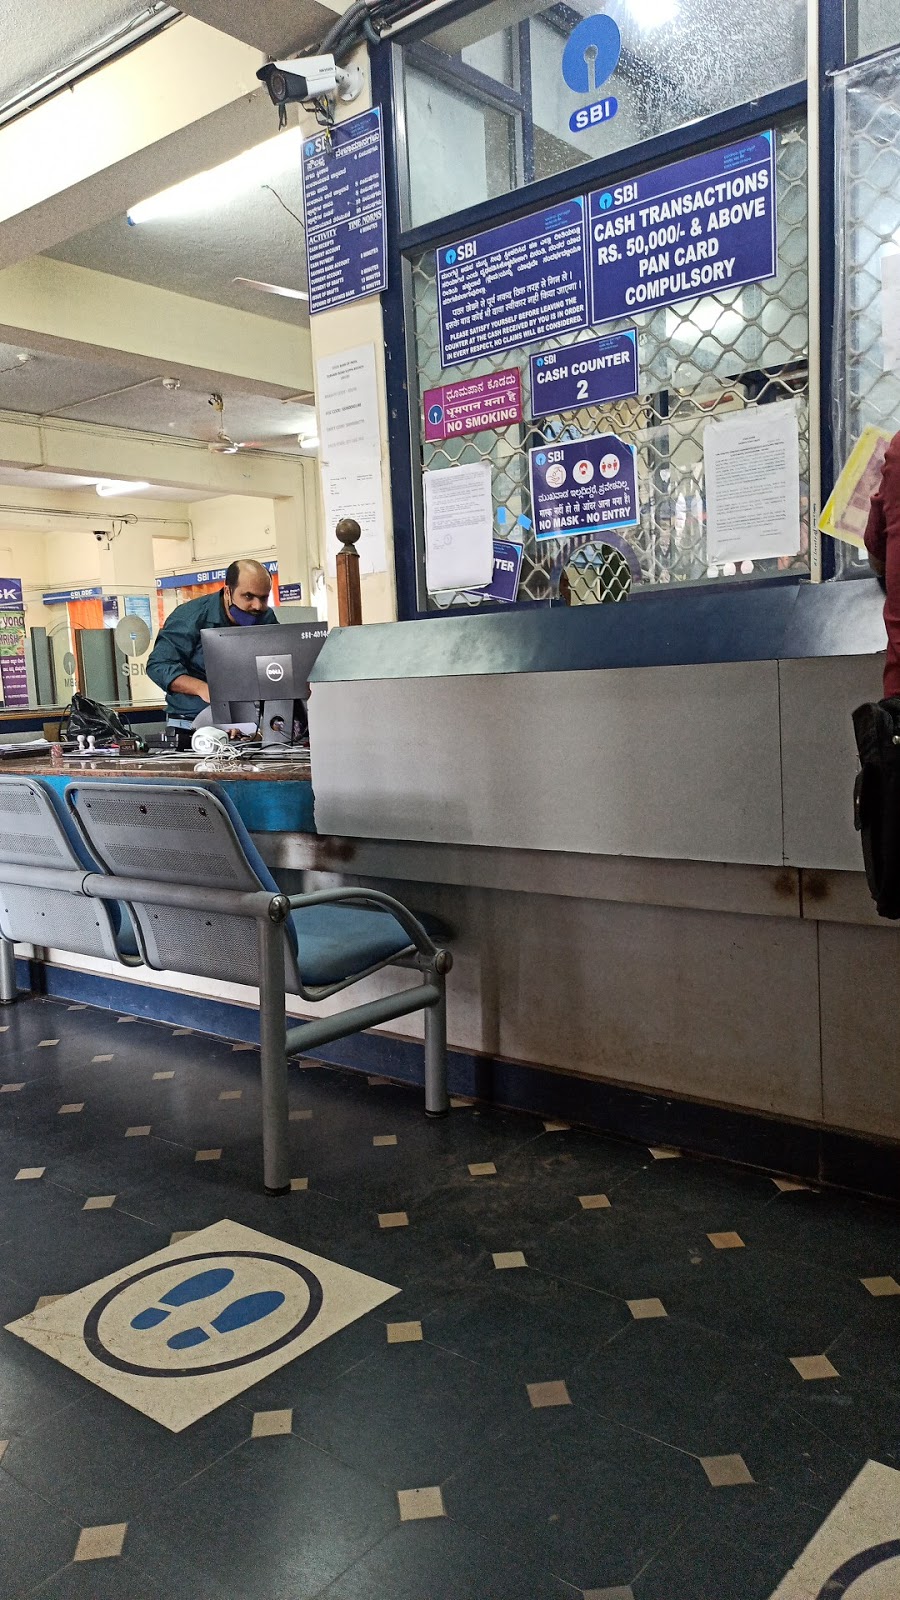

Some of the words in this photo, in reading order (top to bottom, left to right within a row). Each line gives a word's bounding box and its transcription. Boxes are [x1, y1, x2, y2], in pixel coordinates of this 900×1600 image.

[575, 101, 610, 128] SBI
[594, 213, 635, 242] CASH
[639, 169, 769, 227] TRANSACTIONS
[613, 182, 638, 205] SBI
[308, 228, 337, 245] ACTIVITY
[598, 244, 623, 265] RS.
[626, 223, 686, 256] 50,000/-
[690, 217, 702, 237] &
[707, 197, 766, 232] ABOVE
[457, 240, 477, 261] SBI
[639, 252, 670, 277] PAN
[674, 237, 719, 266] CARD
[625, 257, 736, 305] COMPULSORY
[444, 339, 469, 351] COUNTER
[468, 336, 476, 345] AT
[476, 333, 487, 342] THE
[487, 328, 502, 339] CASH
[502, 321, 528, 334] RECEIVED
[528, 317, 537, 327] BY
[537, 314, 549, 324] YOU
[550, 312, 556, 320] IS
[556, 310, 564, 318] IN
[564, 304, 584, 316] ORDER
[449, 329, 469, 341] PLEASE
[469, 322, 490, 335] SATISFY
[490, 314, 518, 328] YOURSELF
[518, 307, 540, 320] BEFORE
[540, 300, 564, 314] LEAVING
[564, 296, 577, 306] THE
[446, 352, 453, 360] IN
[452, 347, 469, 358] EVERY
[493, 338, 502, 347] NO
[502, 331, 523, 344] CLAIMS
[522, 328, 537, 338] WILL
[536, 325, 545, 334] BE
[545, 314, 583, 331] CONSIDERED.
[536, 367, 569, 384] CASH
[571, 351, 631, 376] COUNTER
[543, 353, 557, 366] SBI
[483, 395, 506, 408] मना
[506, 390, 517, 404] है
[576, 380, 589, 399] 2
[447, 418, 462, 432] NO
[465, 407, 518, 429] SMOKING
[547, 450, 565, 463] SBI
[538, 490, 569, 502] ಮುಖವಾಡ
[539, 520, 551, 531] NO
[553, 515, 580, 529] MASK
[586, 512, 600, 523] NO
[602, 507, 631, 520] ENTRY
[197, 572, 209, 582] SBI
[211, 569, 226, 580] LIFE
[493, 557, 515, 573] TER
